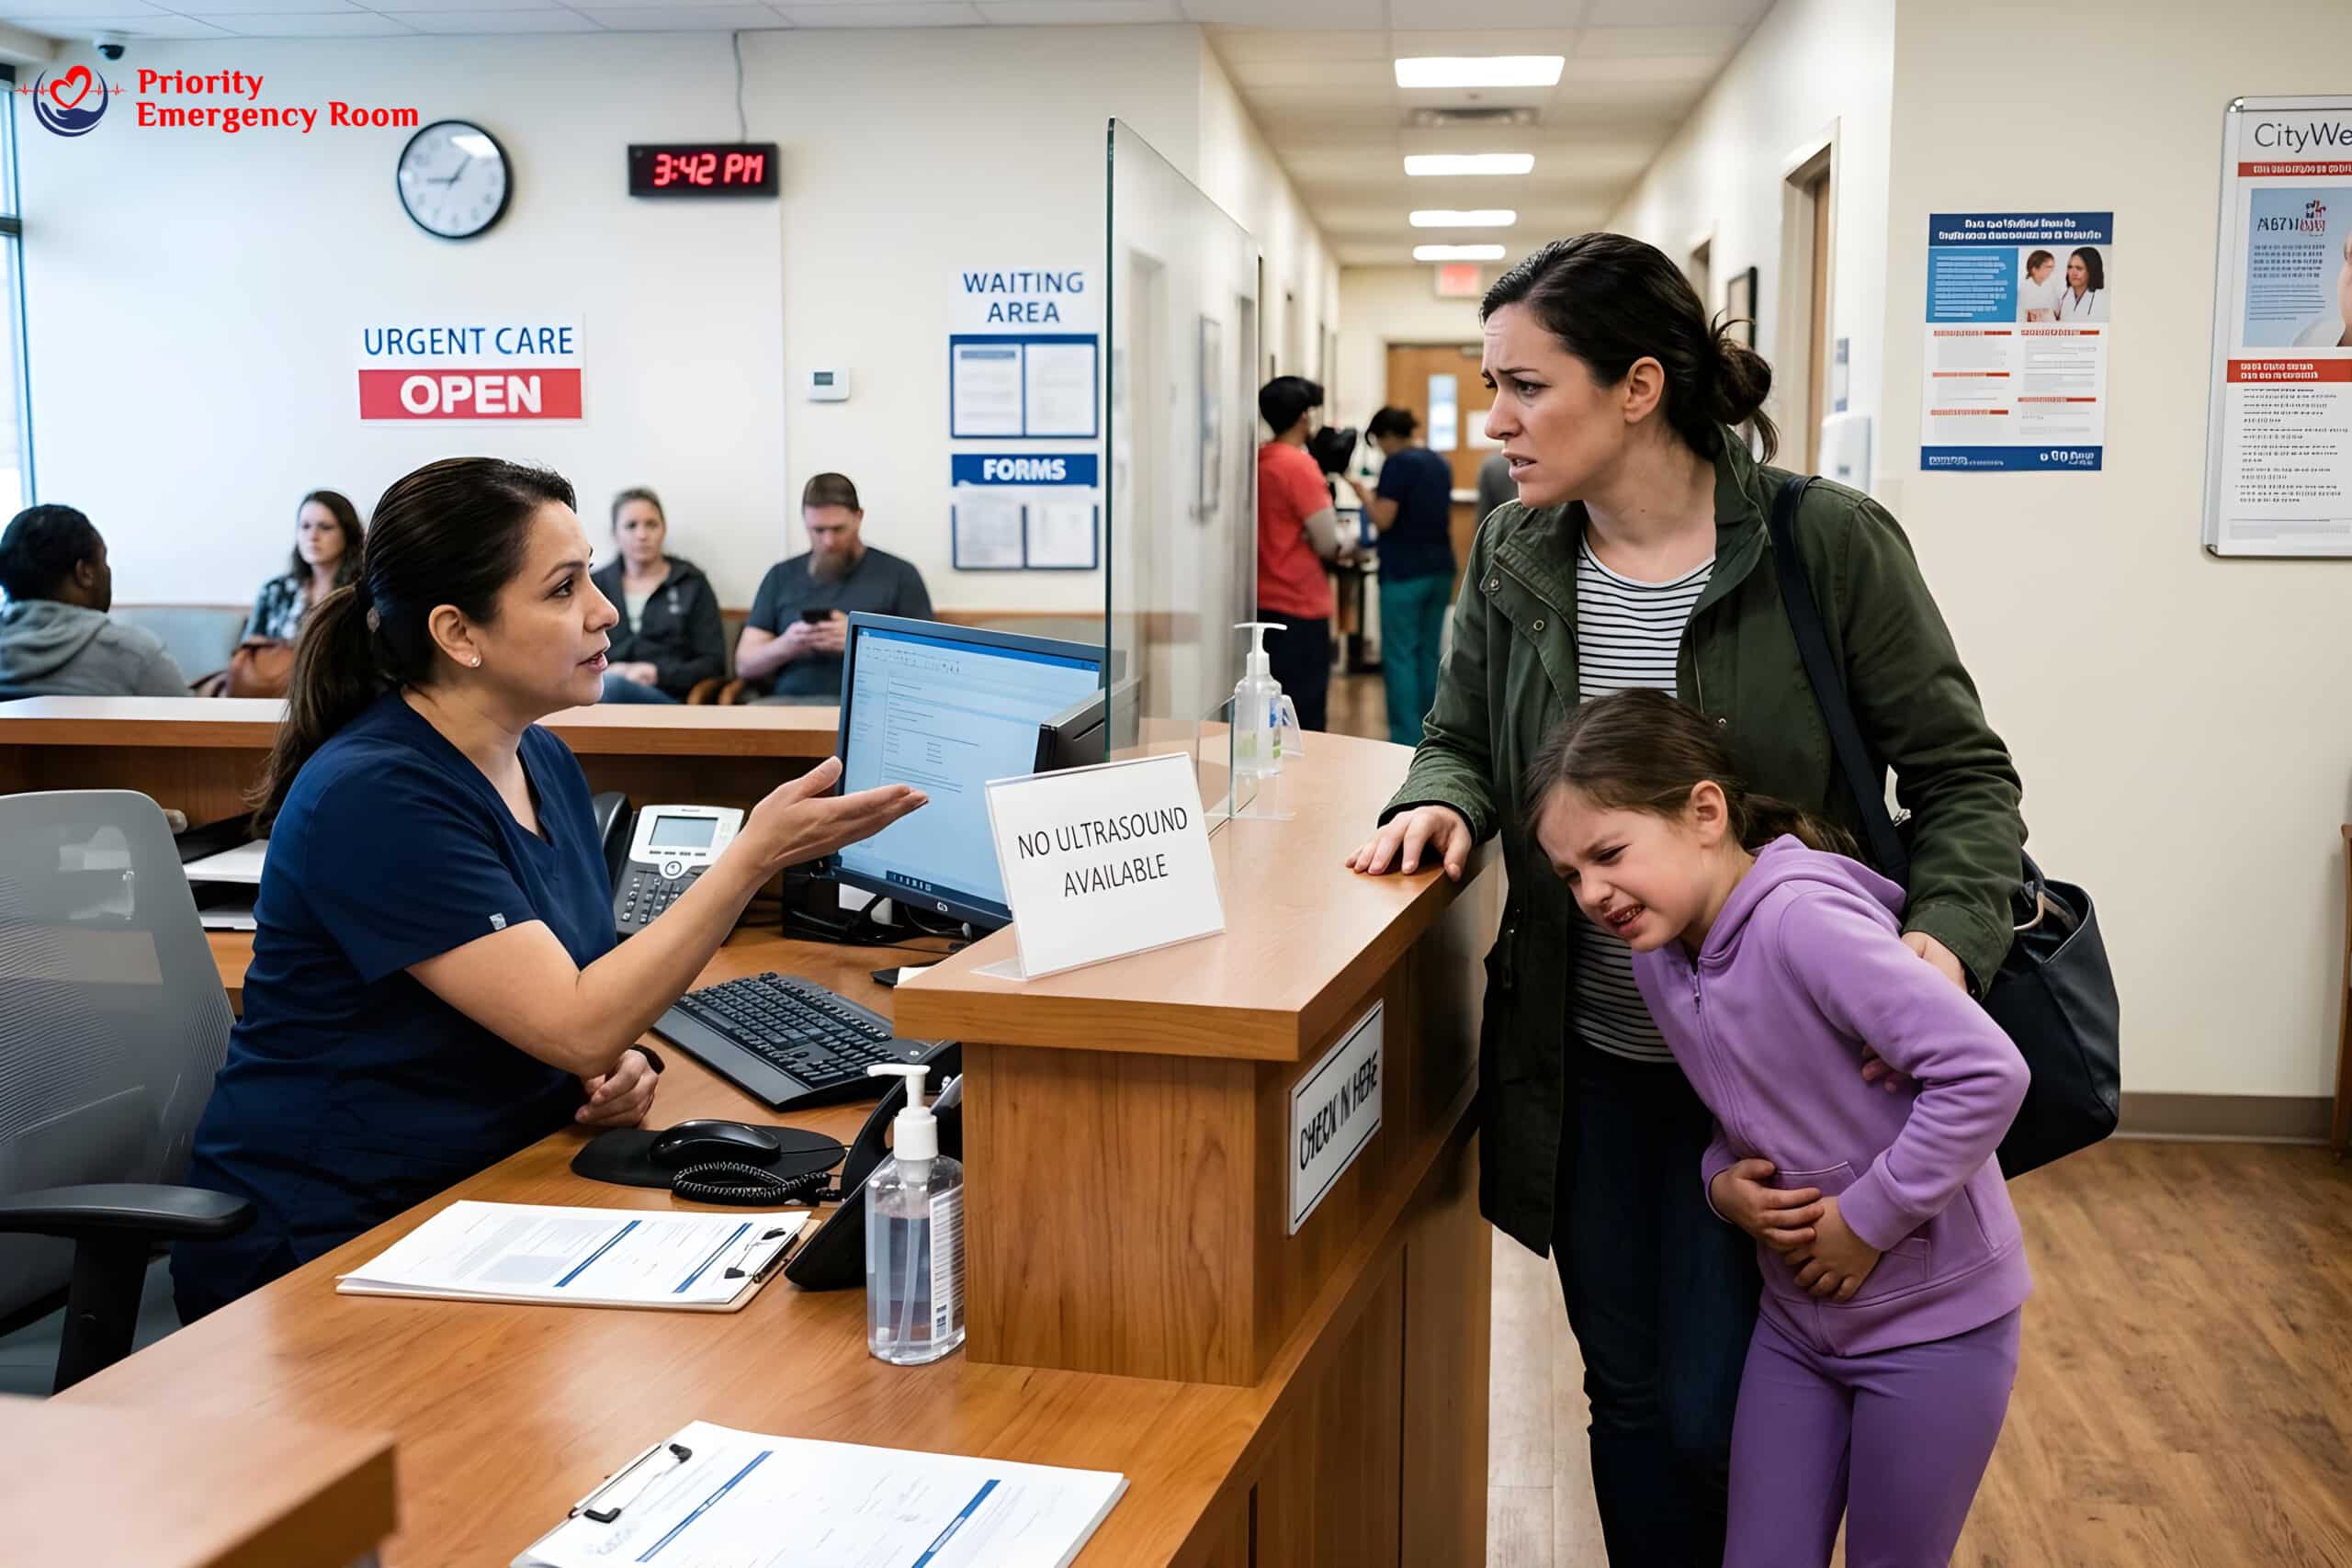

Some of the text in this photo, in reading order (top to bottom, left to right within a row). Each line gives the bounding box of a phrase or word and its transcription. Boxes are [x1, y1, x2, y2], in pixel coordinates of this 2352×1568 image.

[653, 153, 764, 186] 3:42 PM
[963, 272, 1084, 294] WAITING
[987, 301, 1061, 322] AREA
[364, 327, 574, 355] URGENT CARE
[400, 375, 542, 414] OPEN
[983, 458, 1067, 480] FORMS
[1018, 807, 1188, 860] NO ULTRASOUND
[1065, 853, 1170, 897] AVAILABLE
